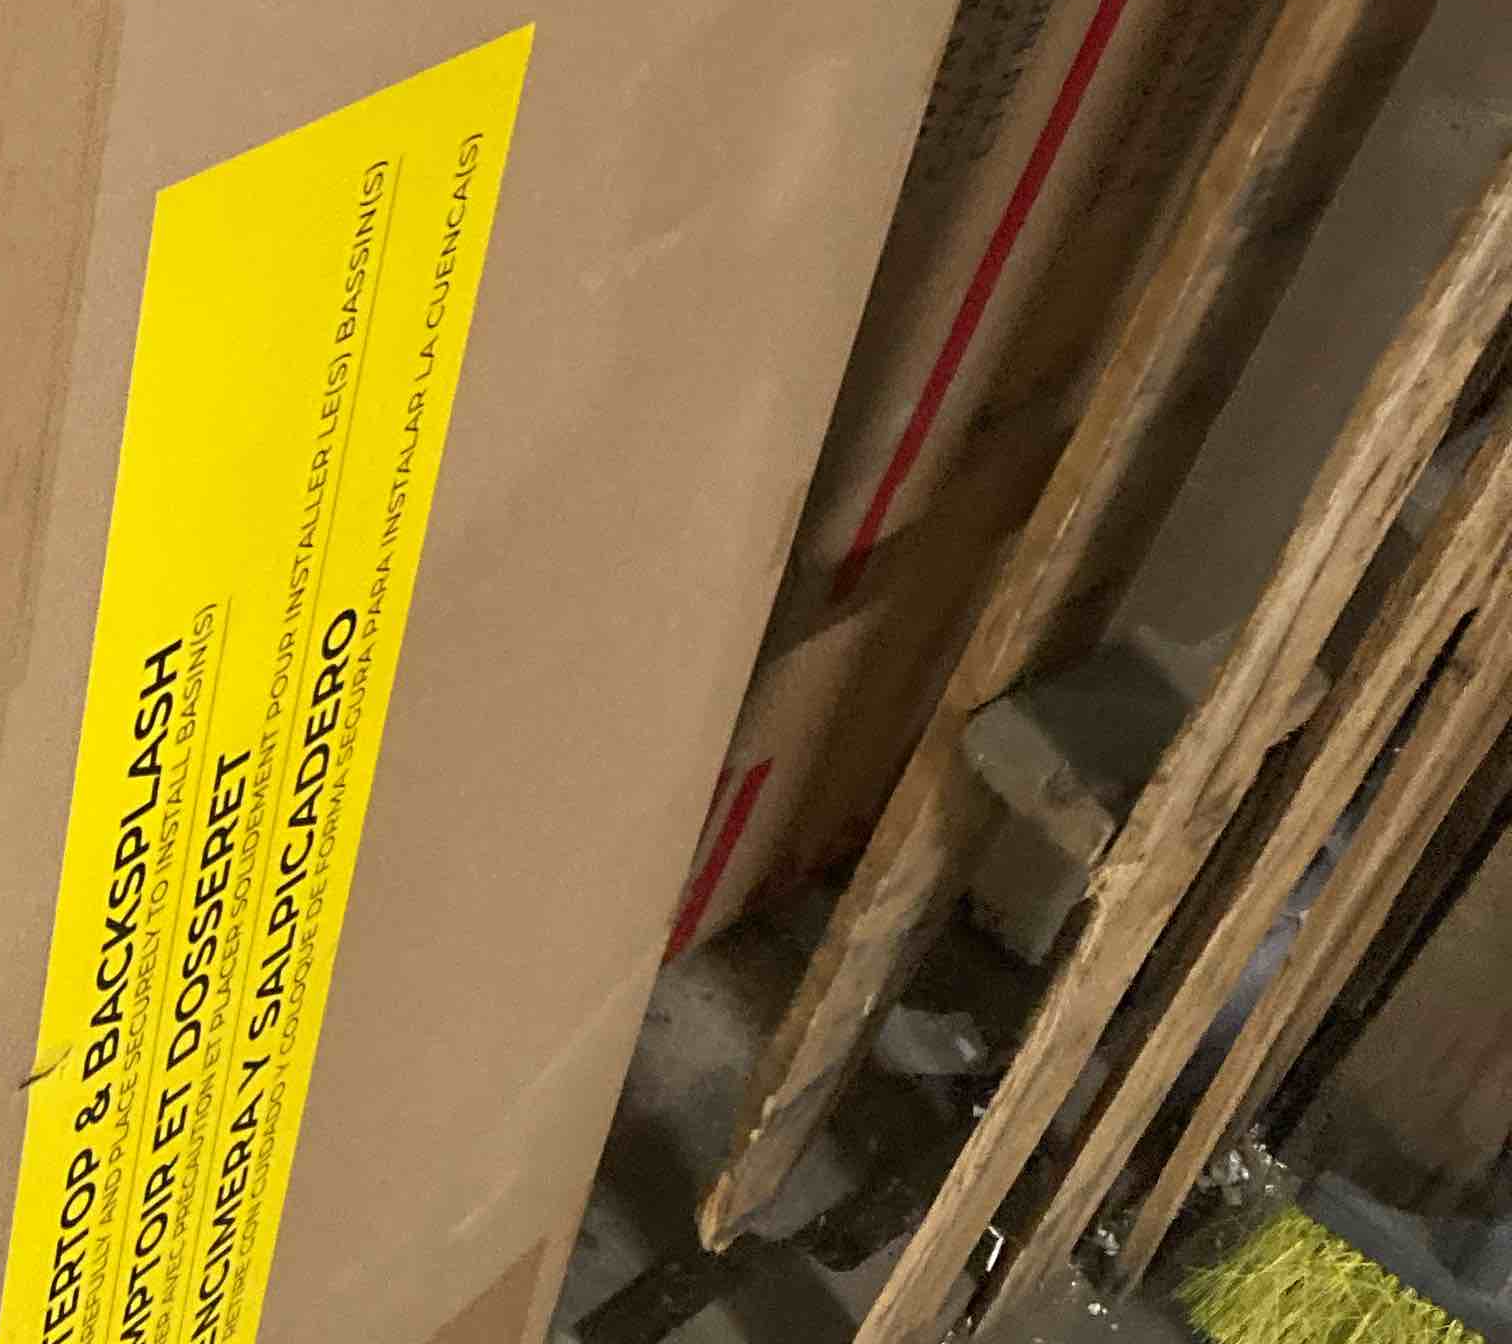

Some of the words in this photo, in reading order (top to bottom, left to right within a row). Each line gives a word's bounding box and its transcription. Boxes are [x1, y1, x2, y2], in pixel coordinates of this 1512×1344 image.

[335, 160, 390, 344] BASSIN(S)
[425, 132, 484, 330] CUENCA(S)
[317, 351, 353, 440] LE(S)
[415, 335, 439, 382] LA
[380, 389, 427, 548] INSTALAR
[284, 445, 333, 623] INSTALLER
[361, 554, 392, 640] PARA
[175, 603, 218, 745] BASIN(S)
[265, 629, 297, 722] POUR
[335, 642, 376, 768] SEGURA
[81, 638, 183, 1082] BACKSPLASH
[154, 747, 192, 875] INSTALL
[230, 730, 279, 919] SOLIDEMENT
[247, 608, 358, 1042] SALPICADERO
[313, 769, 349, 876] FORMA
[146, 878, 170, 923] TO
[165, 750, 252, 1073] DOSSERET
[304, 878, 328, 922] DE
[123, 928, 161, 1073] SECURELY
[208, 924, 242, 1033] PLACER
[278, 924, 319, 1056] COLOQUE
[74, 1082, 112, 1133] &
[202, 1037, 222, 1071] ET
[237, 1054, 271, 1095] Y
[107, 1072, 139, 1166] PLACE
[151, 1082, 192, 1154] ET
[250, 1085, 287, 1200] CUIDADO
[98, 1167, 123, 1226] AND
[238, 1200, 262, 1258] CON
[160, 1239, 186, 1305] AVEC
[220, 1258, 251, 1343] RETIRE
